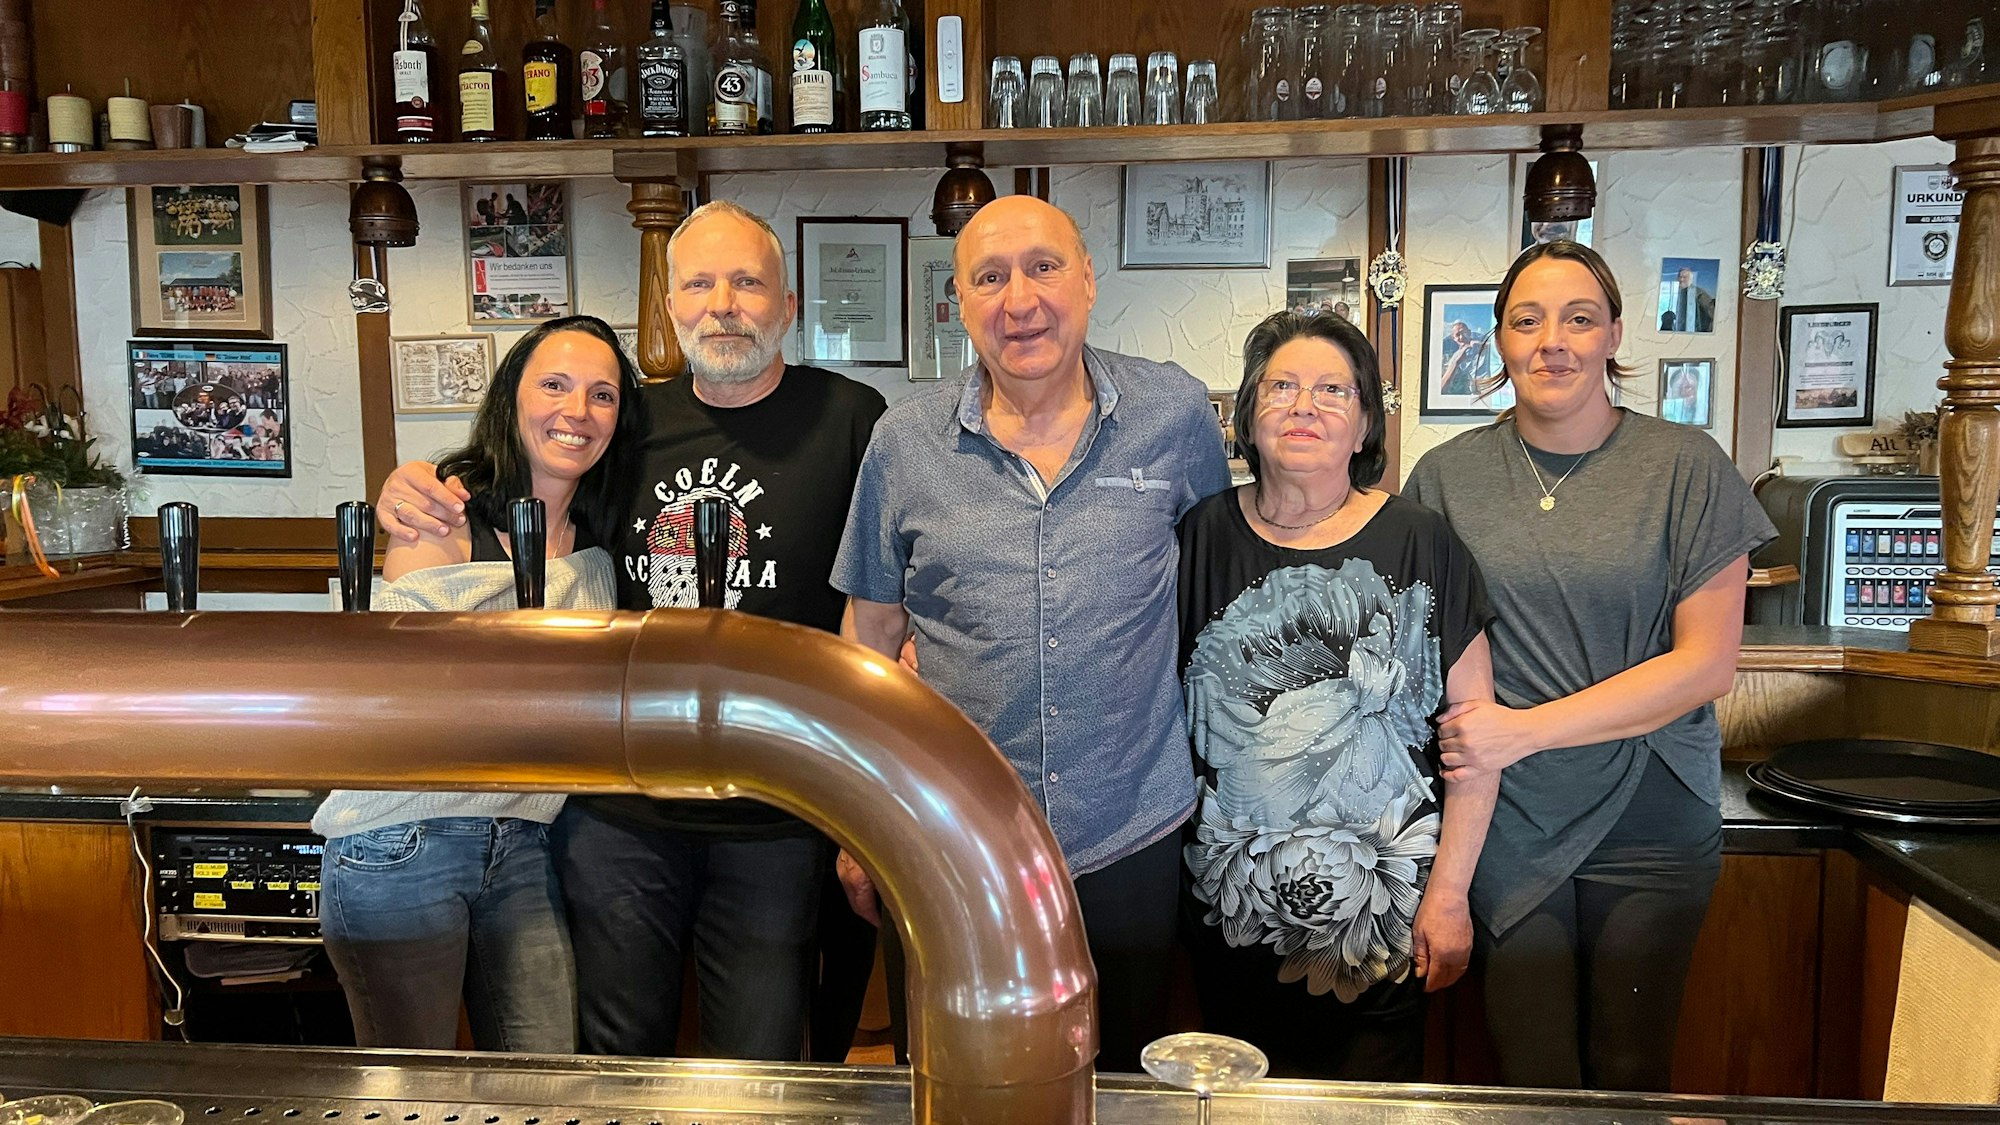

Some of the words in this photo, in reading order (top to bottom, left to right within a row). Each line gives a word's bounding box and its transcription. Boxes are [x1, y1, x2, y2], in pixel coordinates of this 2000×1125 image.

[726, 4, 737, 12] 43
[525, 69, 550, 79] ERANO
[582, 68, 600, 87] 03
[641, 66, 656, 79] JACK
[862, 65, 898, 82] Sambuca
[460, 81, 490, 91] riacron
[721, 77, 742, 92] 43
[1907, 193, 1963, 203] URKUND
[490, 262, 502, 271] Wir
[503, 262, 538, 271] bedanken
[654, 457, 765, 508] COELN
